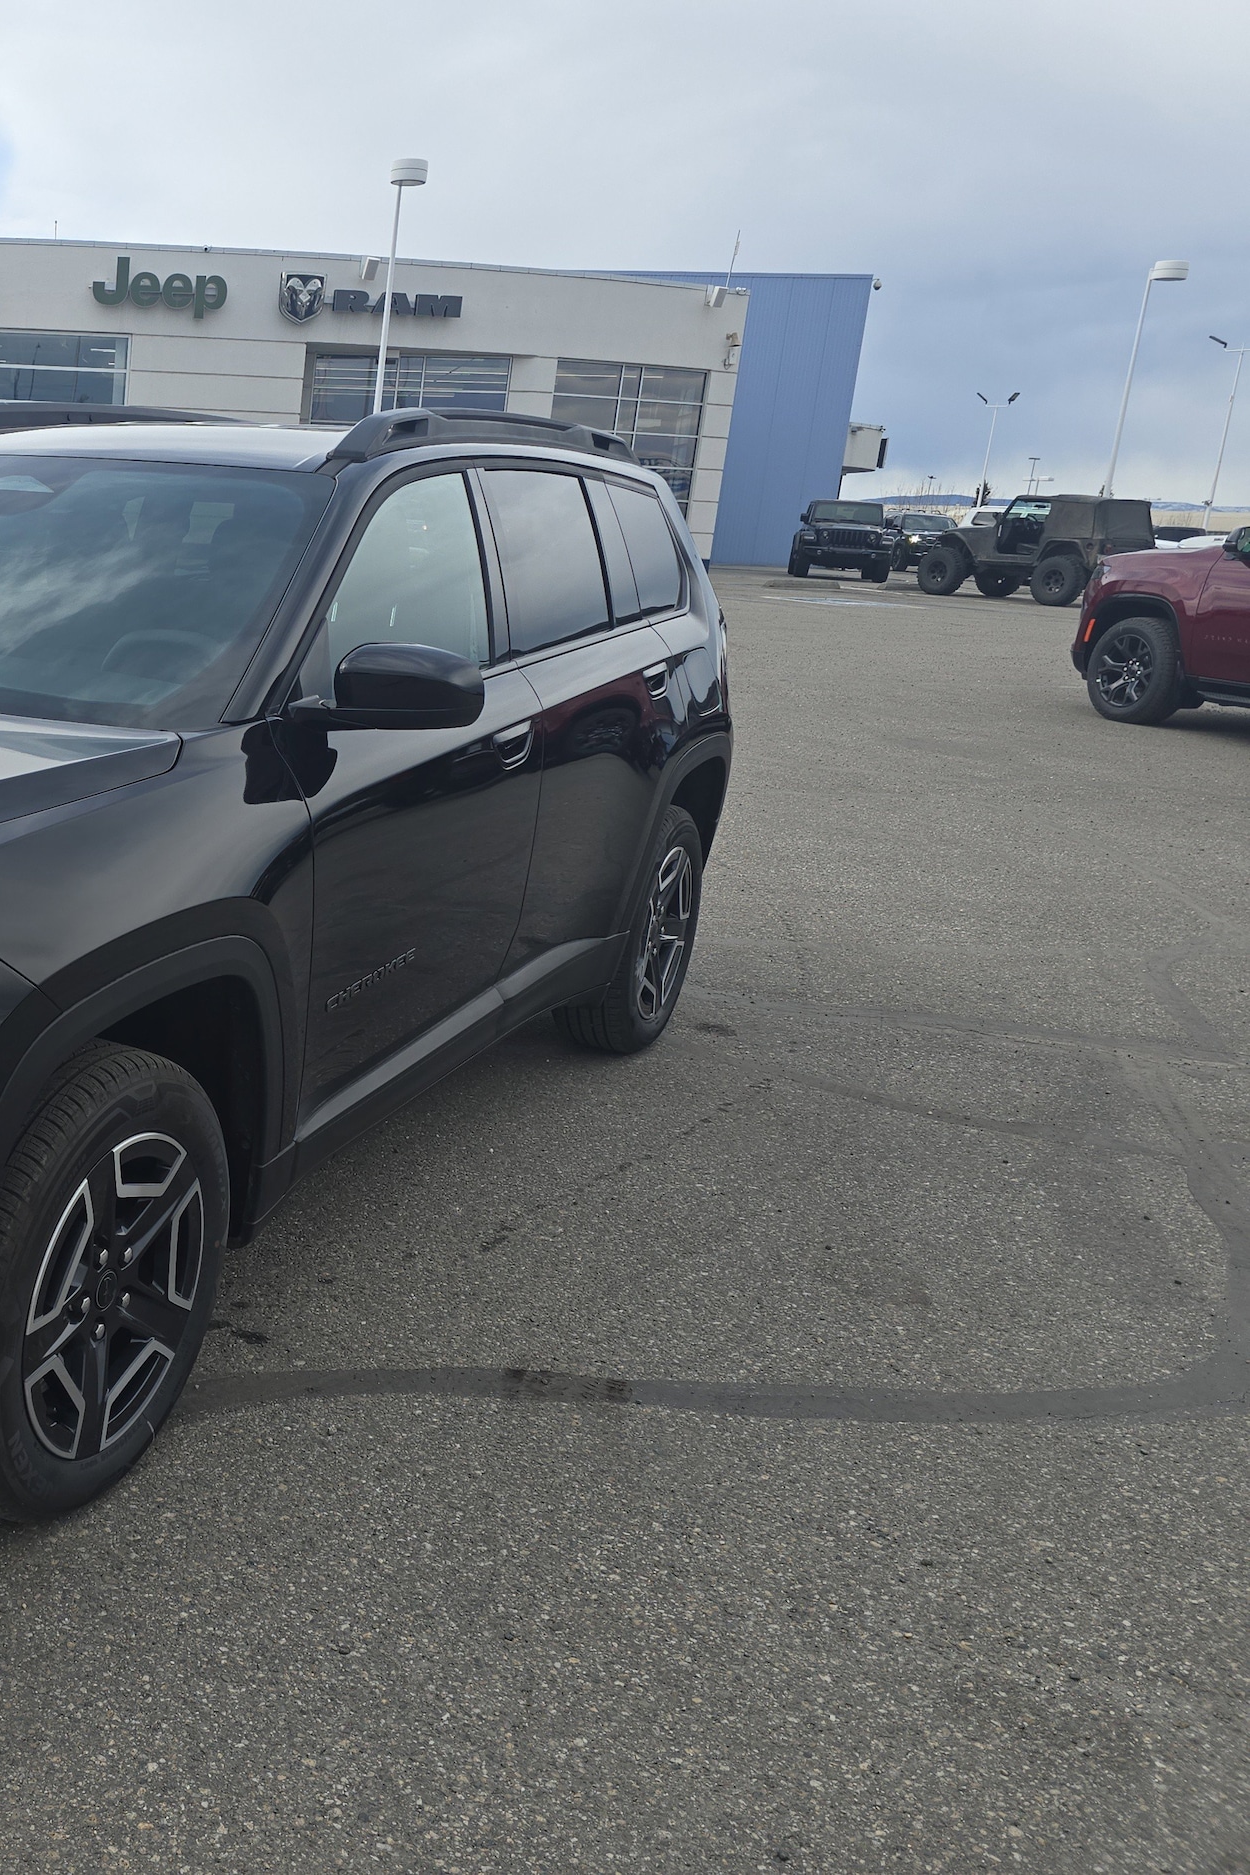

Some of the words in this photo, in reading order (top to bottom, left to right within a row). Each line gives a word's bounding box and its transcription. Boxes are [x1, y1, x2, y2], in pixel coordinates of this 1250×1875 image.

[92, 256, 228, 320] Jeep
[333, 289, 463, 318] RAM
[325, 947, 417, 1013] CHEROKEE
